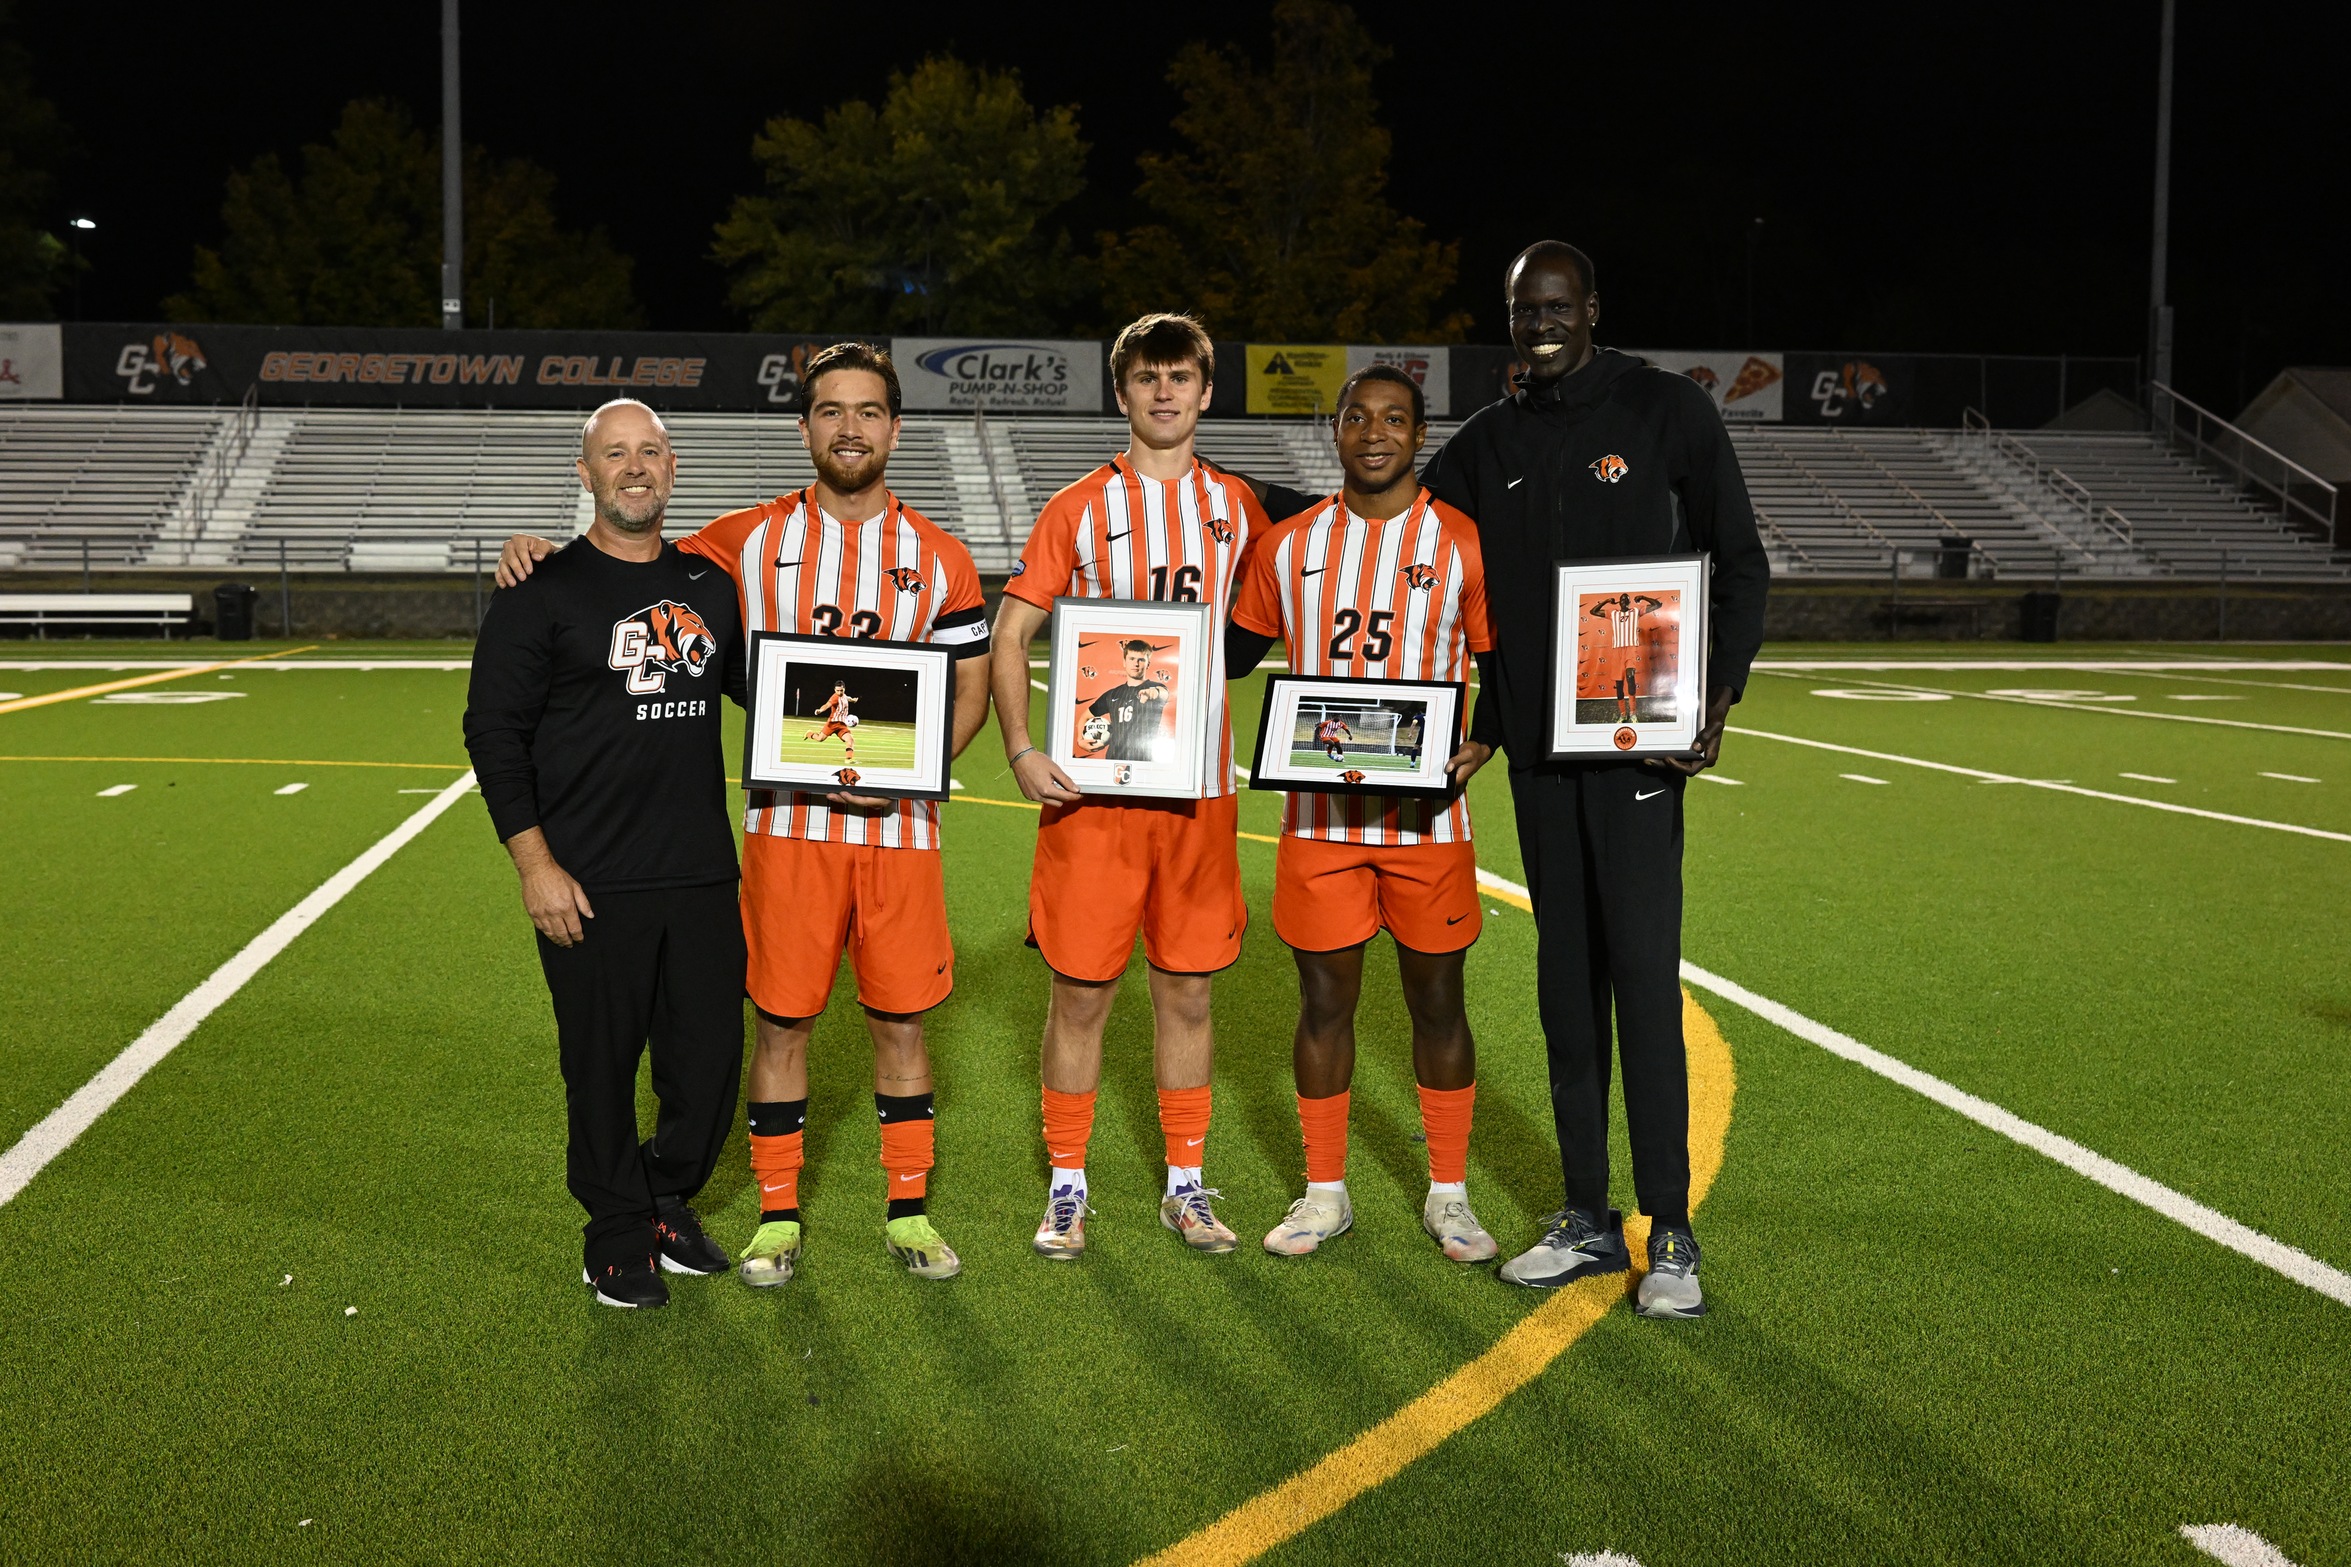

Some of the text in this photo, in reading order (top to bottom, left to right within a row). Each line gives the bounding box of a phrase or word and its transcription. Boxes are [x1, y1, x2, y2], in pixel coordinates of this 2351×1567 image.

[260, 351, 706, 387] GEORGETOWN COLLEGE
[957, 353, 1067, 381] Clark's
[950, 382, 1068, 396] PUMP-N-SHOP
[1150, 565, 1202, 602] 16
[1327, 608, 1396, 662] 25
[636, 700, 706, 720] SOCCER
[1118, 705, 1133, 723] 16
